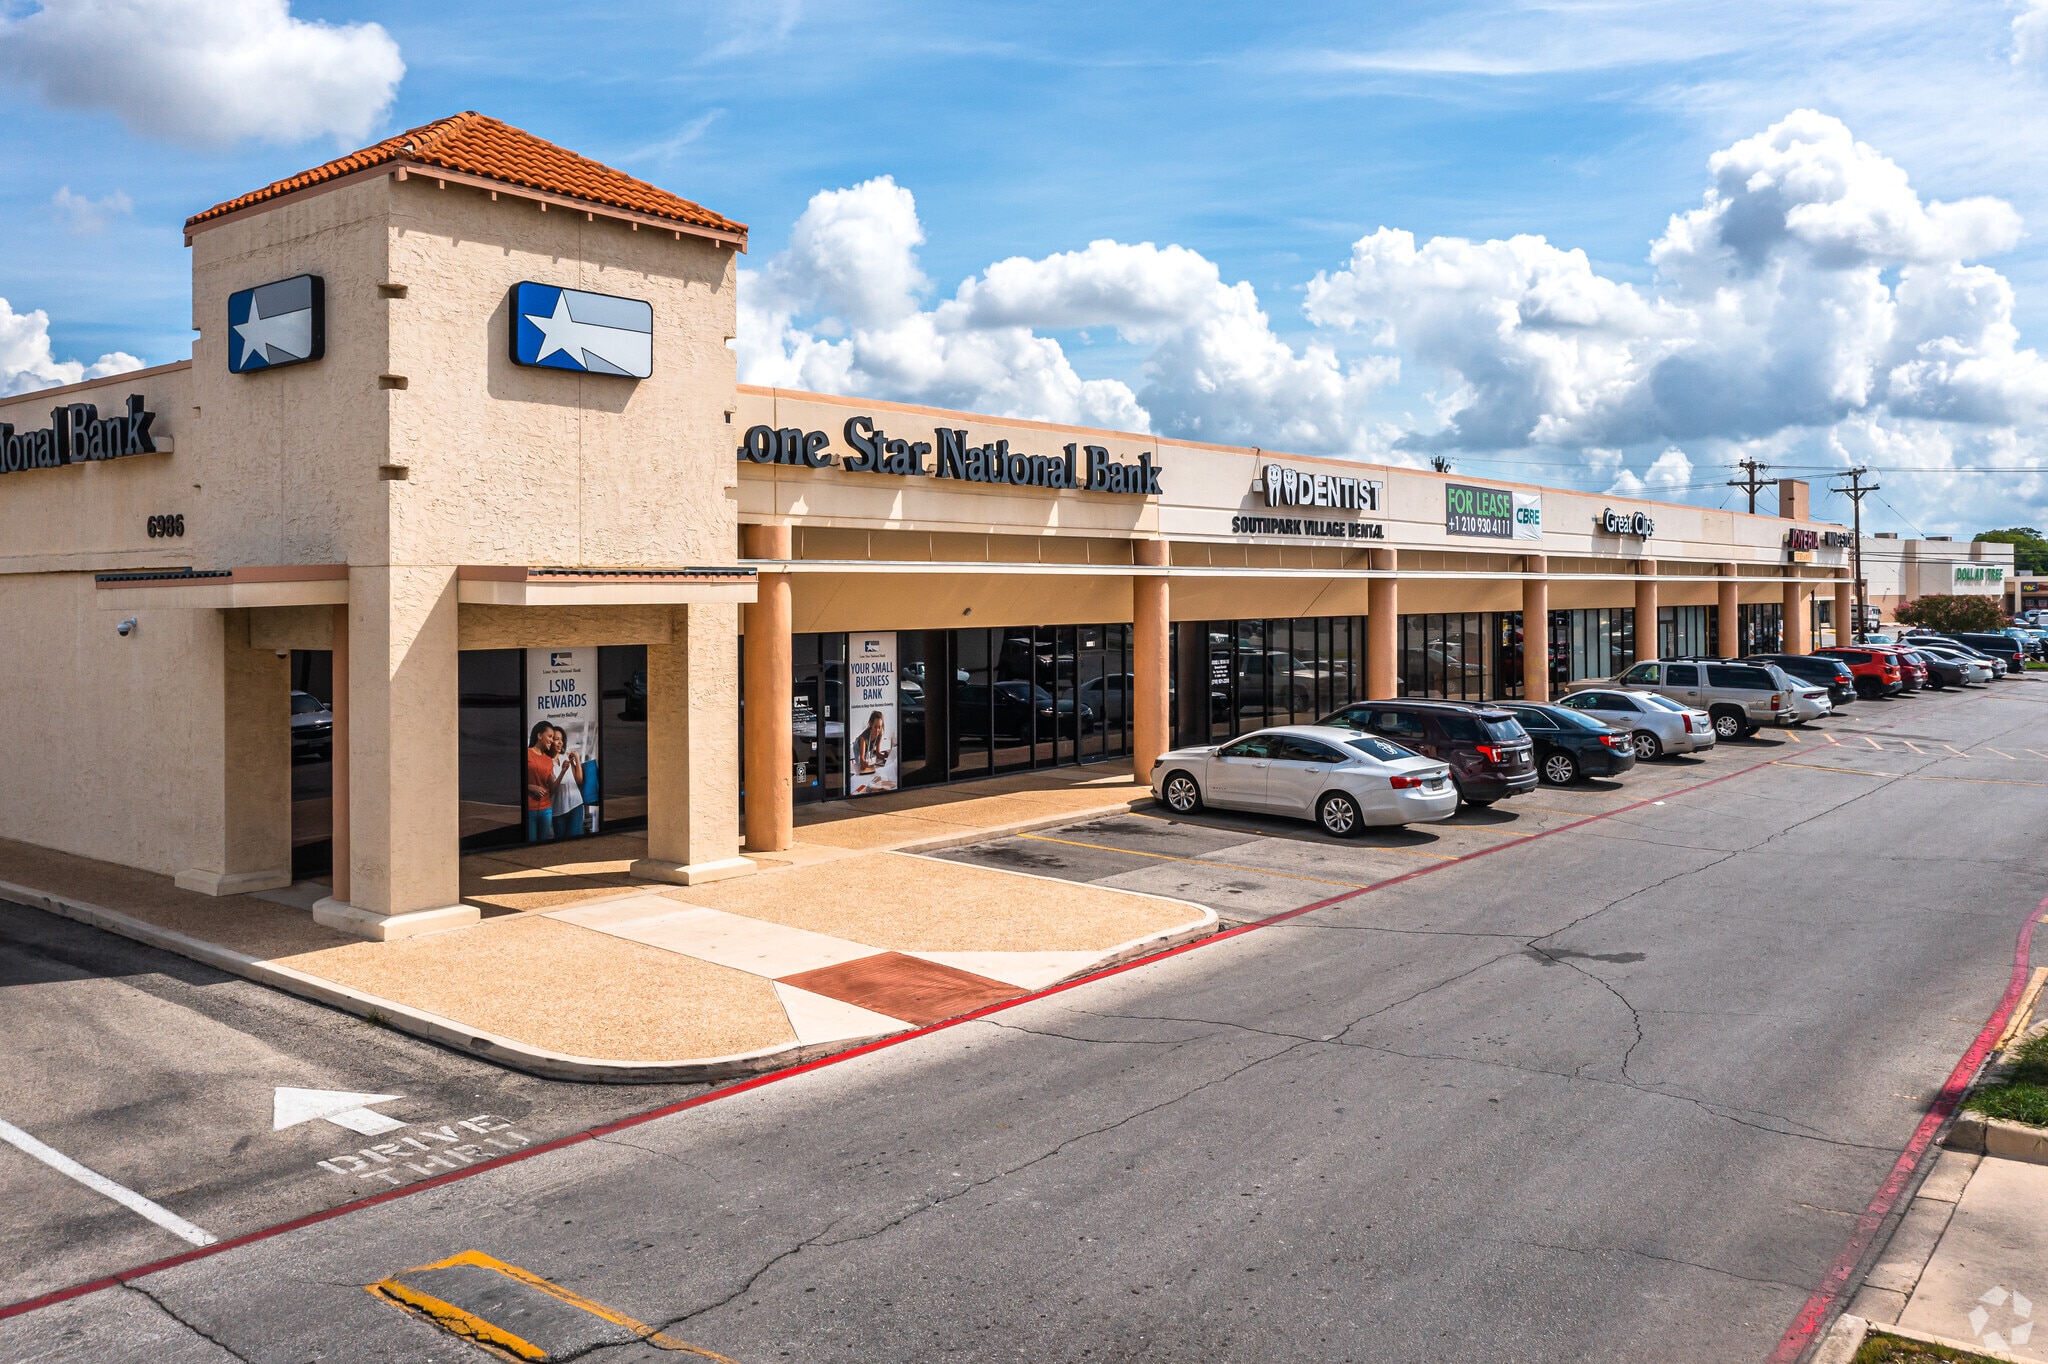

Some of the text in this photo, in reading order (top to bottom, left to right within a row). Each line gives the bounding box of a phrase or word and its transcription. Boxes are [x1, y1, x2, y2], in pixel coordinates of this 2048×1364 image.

[67, 394, 156, 463] Bank
[737, 416, 1163, 495] one Star National Bank
[1298, 473, 1384, 510] DENTIST
[1448, 488, 1510, 518] FOR LEASE
[147, 514, 185, 538] 6986
[1231, 516, 1385, 539] SOUTHPARK VILLAGE DENTAL
[1449, 515, 1511, 535] +1 210 930 4111
[1516, 508, 1540, 525] CBRE
[1603, 508, 1656, 541] Great Clips
[1788, 528, 1819, 550] JOYERIA
[1955, 568, 2004, 581] DOLLAR TREE
[851, 661, 895, 675] YOUR SMALL
[549, 678, 576, 693] LSNB
[856, 675, 890, 688] BUSINESS
[537, 693, 587, 710] REWARDS
[863, 688, 883, 700] BANK
[316, 1114, 515, 1176] DRIVE
